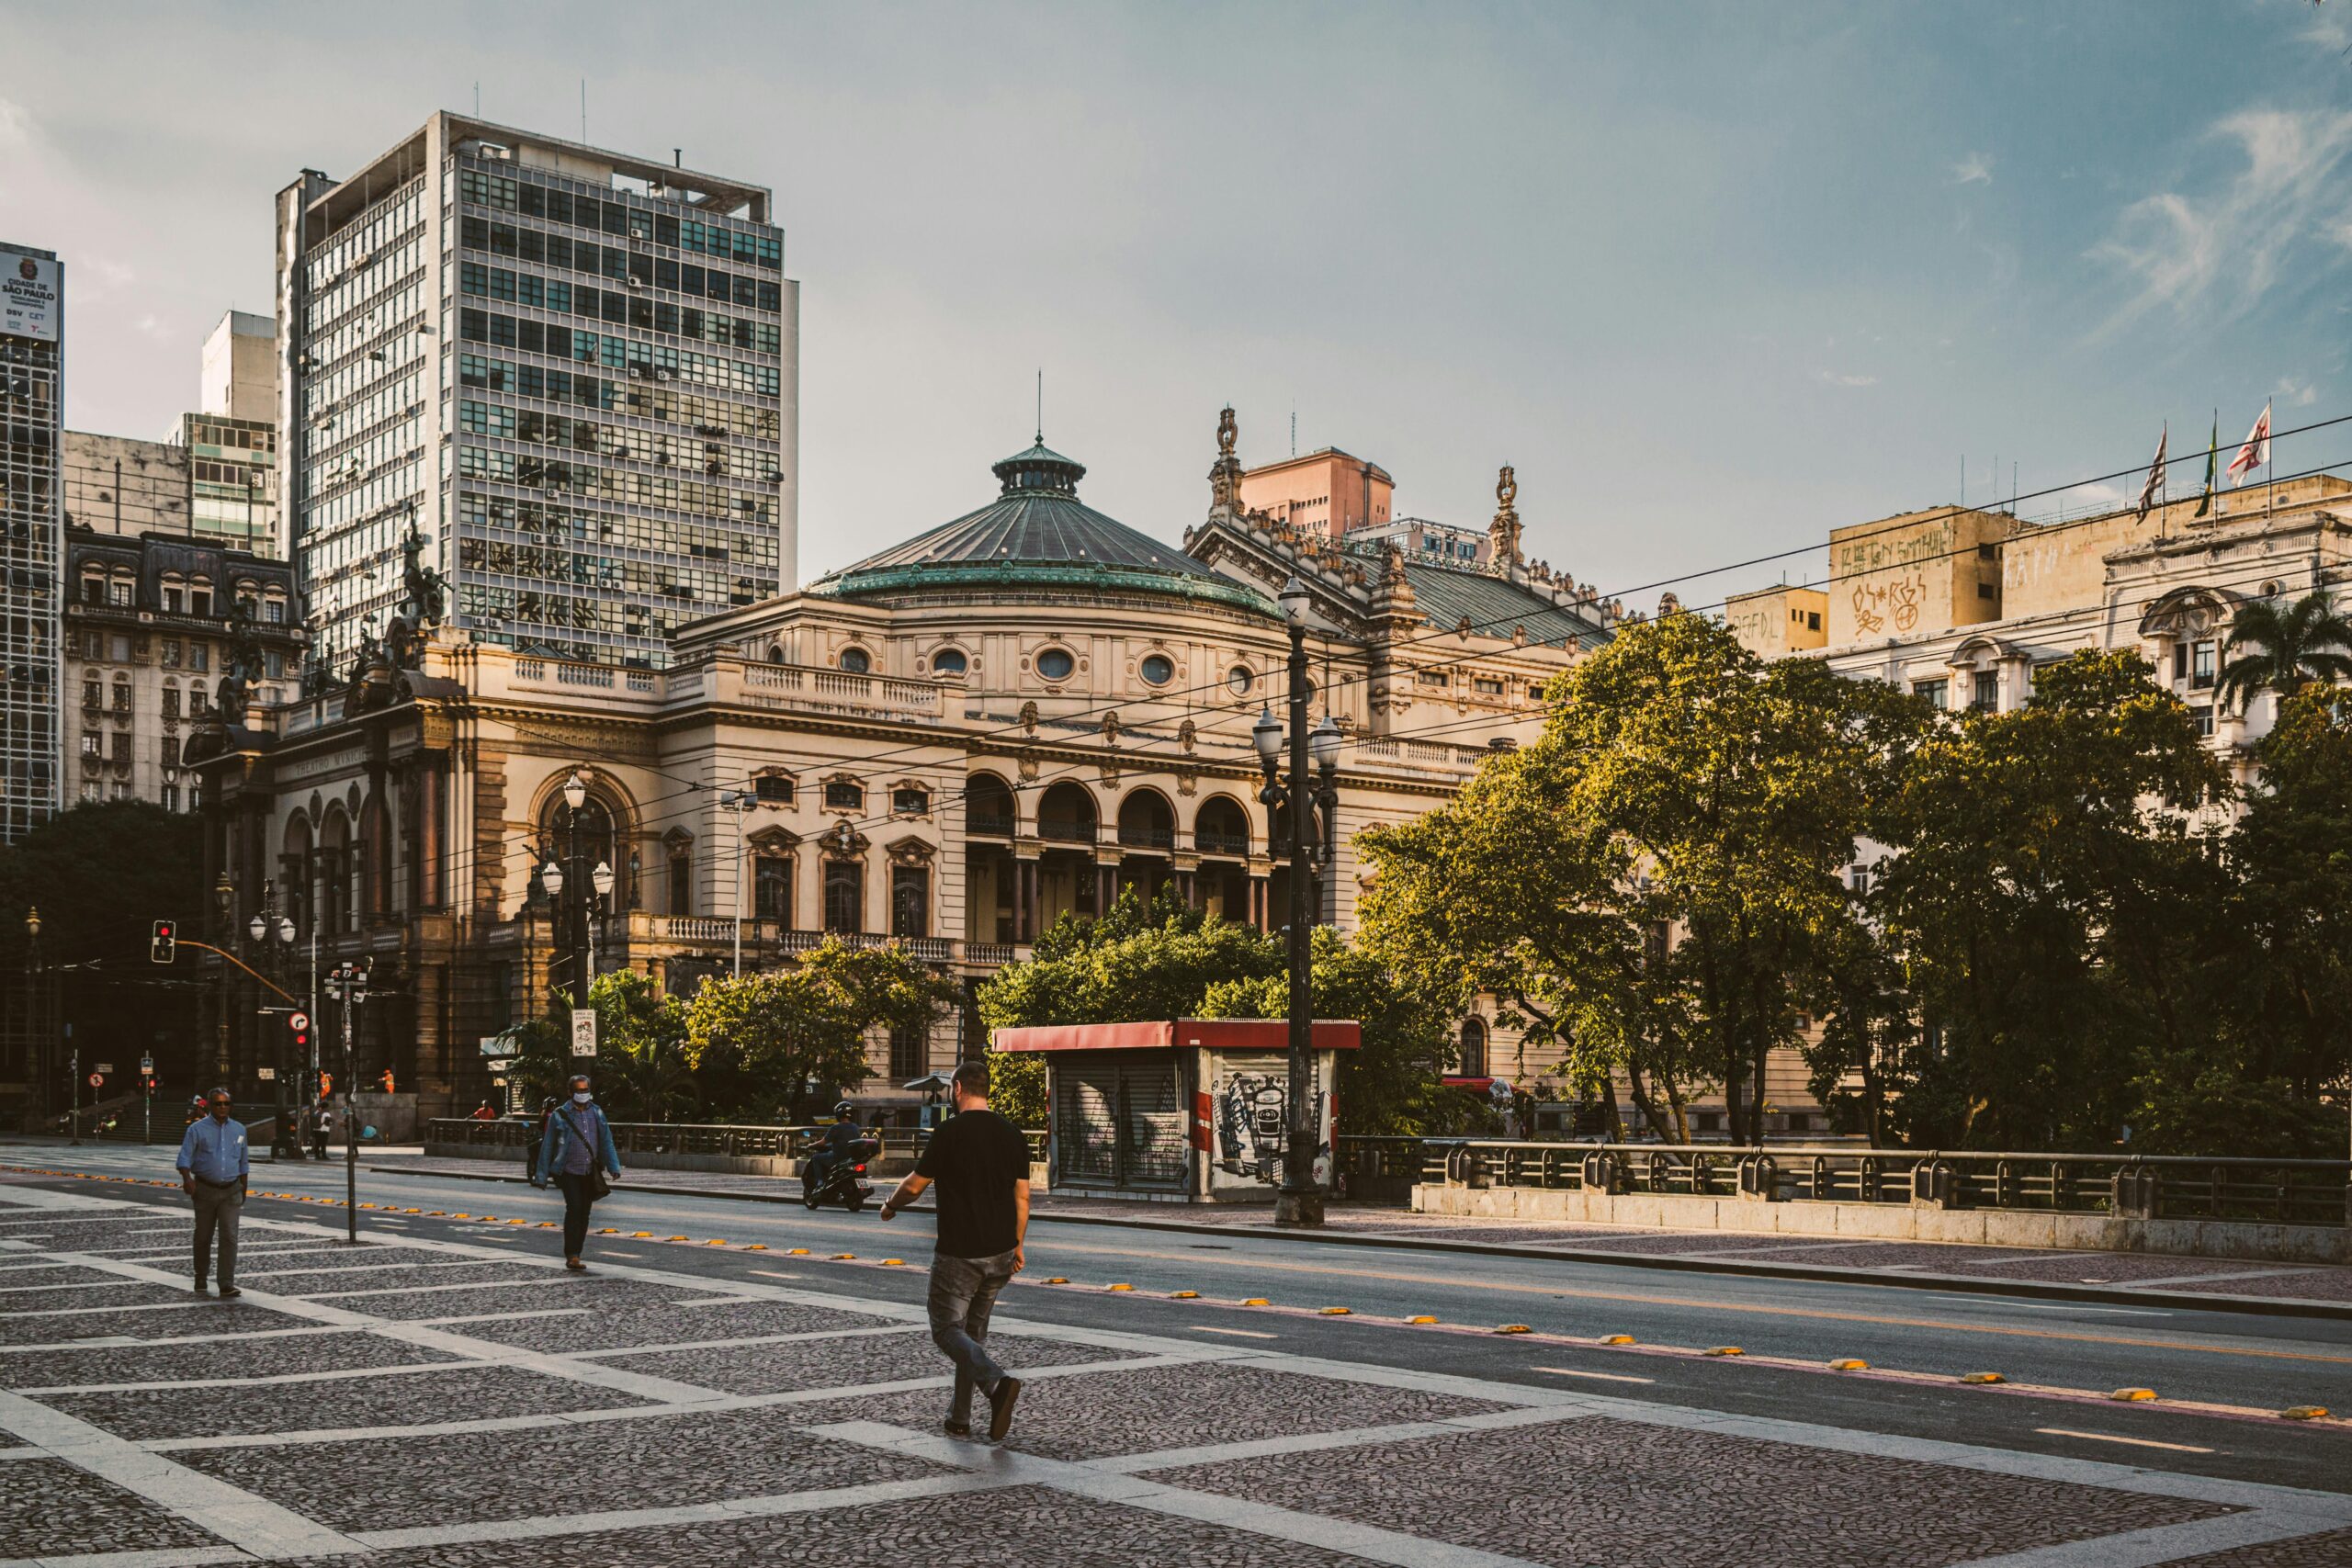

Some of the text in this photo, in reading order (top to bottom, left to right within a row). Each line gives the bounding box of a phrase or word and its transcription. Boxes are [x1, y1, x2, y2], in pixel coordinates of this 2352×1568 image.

[8, 278, 35, 289] CIDADE
[2, 284, 55, 300] SÃO PAULO
[29, 312, 45, 321] CET
[294, 758, 329, 776] THEATRO
